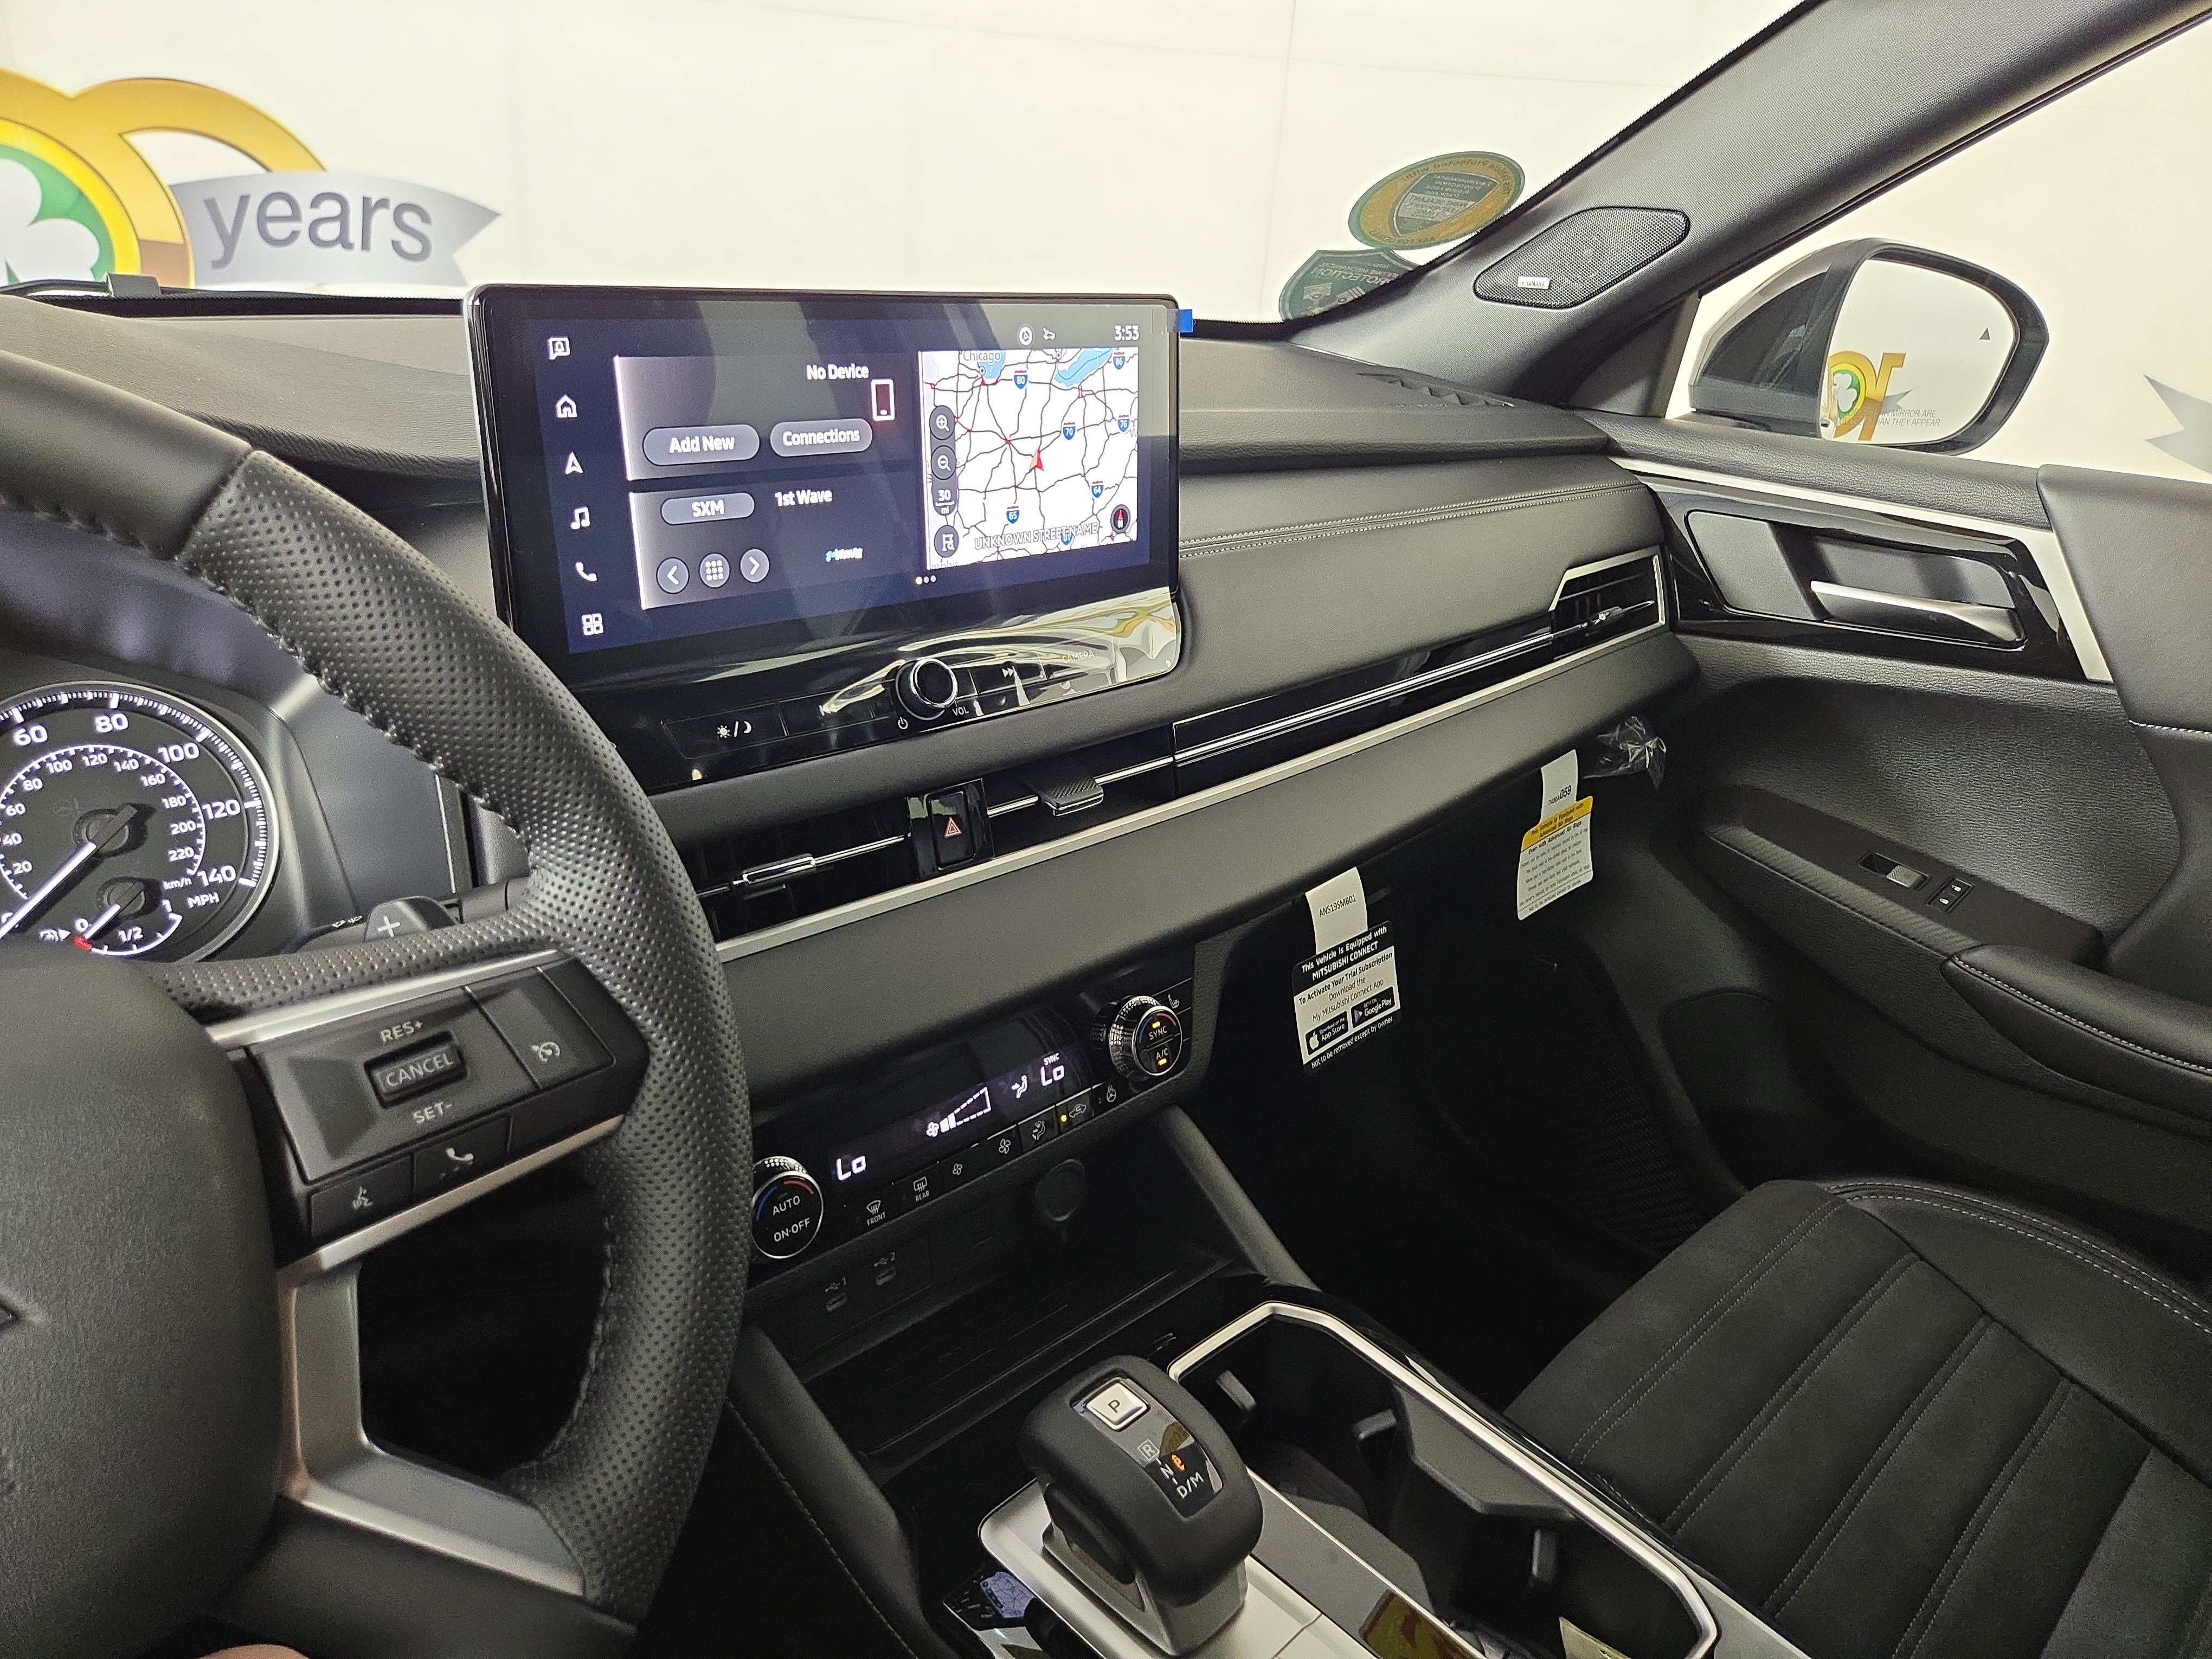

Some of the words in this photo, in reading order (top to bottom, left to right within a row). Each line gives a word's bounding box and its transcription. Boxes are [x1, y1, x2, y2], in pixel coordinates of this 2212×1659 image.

[203, 190, 433, 270] years
[1114, 325, 1139, 341] 3:53
[963, 350, 1001, 363] Chicago
[807, 365, 826, 380] No
[828, 364, 870, 380] Device
[1017, 376, 1025, 384] 80
[1892, 409, 1920, 417] MIRROR
[1911, 419, 1941, 427] APPEAR
[669, 436, 700, 453] Add
[703, 435, 735, 451] New
[783, 428, 860, 446] Connections
[775, 491, 795, 506] 1st
[796, 489, 833, 505] Wave
[938, 490, 951, 501] 30
[692, 500, 725, 516] SXM
[1009, 511, 1018, 520] 65
[974, 531, 1032, 550] UNKNOWN
[1032, 527, 1068, 543] STREET
[1068, 522, 1098, 537] NAME
[1062, 650, 1096, 664] CAMERA
[951, 707, 969, 716] VOL
[94, 713, 128, 733] 80
[14, 725, 48, 746] 60
[82, 753, 108, 767] 120
[158, 742, 200, 763] 100
[47, 760, 73, 774] 100
[114, 758, 139, 773] 140
[23, 777, 43, 791] 80
[140, 773, 166, 787] 160
[5, 802, 26, 817] 60
[162, 795, 187, 809] 180
[202, 799, 241, 820] 120
[170, 820, 196, 835] 200
[3, 832, 22, 846] 40
[168, 846, 195, 862] 220
[12, 860, 33, 874] 20
[163, 877, 192, 890] km/h
[197, 865, 237, 887] 140
[187, 892, 220, 909] MPH
[75, 918, 89, 932] 0
[118, 927, 144, 942] 1/2
[1301, 963, 1314, 974] This
[1316, 950, 1336, 967] Vehicle
[1339, 947, 1344, 955] is
[1346, 932, 1372, 951] Equipped
[1374, 925, 1387, 938] with
[1312, 955, 1349, 981] MITSUBISHI
[1349, 941, 1378, 962] CONNECT
[1299, 998, 1306, 1006] To
[1307, 984, 1331, 1002] Activate
[1332, 977, 1345, 989] Your
[1345, 967, 1358, 981] Trial
[1359, 951, 1393, 974] Subscription
[1329, 981, 1356, 1001] Download
[1356, 976, 1366, 986] the
[1312, 1013, 1322, 1023] My
[1322, 995, 1349, 1017] Mitsubishi
[1350, 985, 1372, 1002] Connect
[1373, 979, 1384, 990] App
[1364, 1003, 1382, 1017] Google
[1381, 998, 1392, 1007] Play
[380, 1020, 424, 1043] RES+
[1149, 1025, 1168, 1040] SYNC
[1321, 1031, 1332, 1043] App
[1332, 1023, 1345, 1036] Store
[1311, 1058, 1321, 1070] Not
[1326, 1051, 1333, 1059] be
[1333, 1037, 1354, 1055] removed
[1354, 1027, 1371, 1043] except
[1371, 1024, 1377, 1033] by
[1378, 1015, 1395, 1030] owner.
[1044, 1052, 1060, 1066] SYNC
[1156, 1047, 1169, 1059] A/C
[385, 1053, 454, 1087] CANCEL
[1040, 1065, 1064, 1086] Lo
[413, 1102, 453, 1124] SET-
[836, 1155, 866, 1181] Lo
[916, 1191, 930, 1202] REAR
[773, 1195, 801, 1216] AUTO
[867, 1211, 886, 1226] FRONT
[1107, 1399, 1121, 1413] P
[1142, 1443, 1155, 1458] R
[1160, 1463, 1174, 1480] N
[1176, 1471, 1204, 1499] D/M
